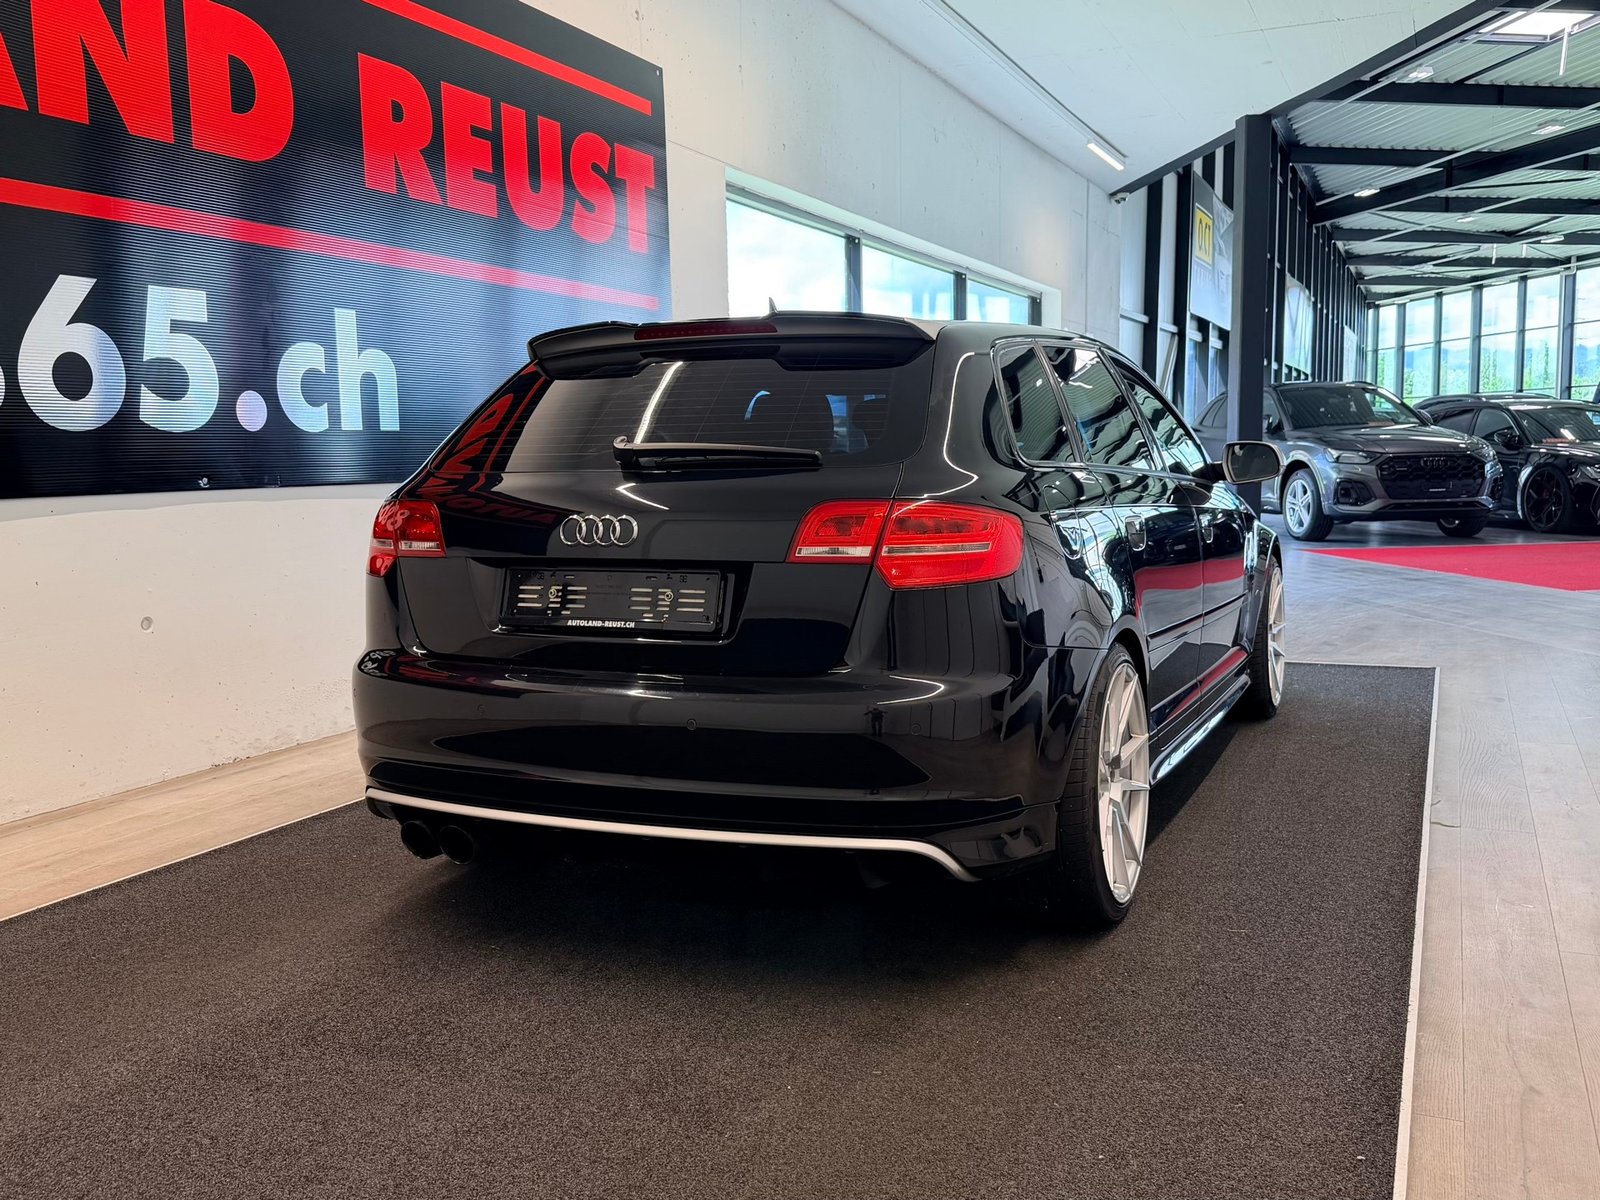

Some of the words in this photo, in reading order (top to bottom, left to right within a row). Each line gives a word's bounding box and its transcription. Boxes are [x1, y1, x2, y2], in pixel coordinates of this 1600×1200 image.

[357, 52, 655, 253] REUST
[0, 274, 400, 433] 65.ch
[567, 619, 635, 628] AUTOLAND-REUST.CH
